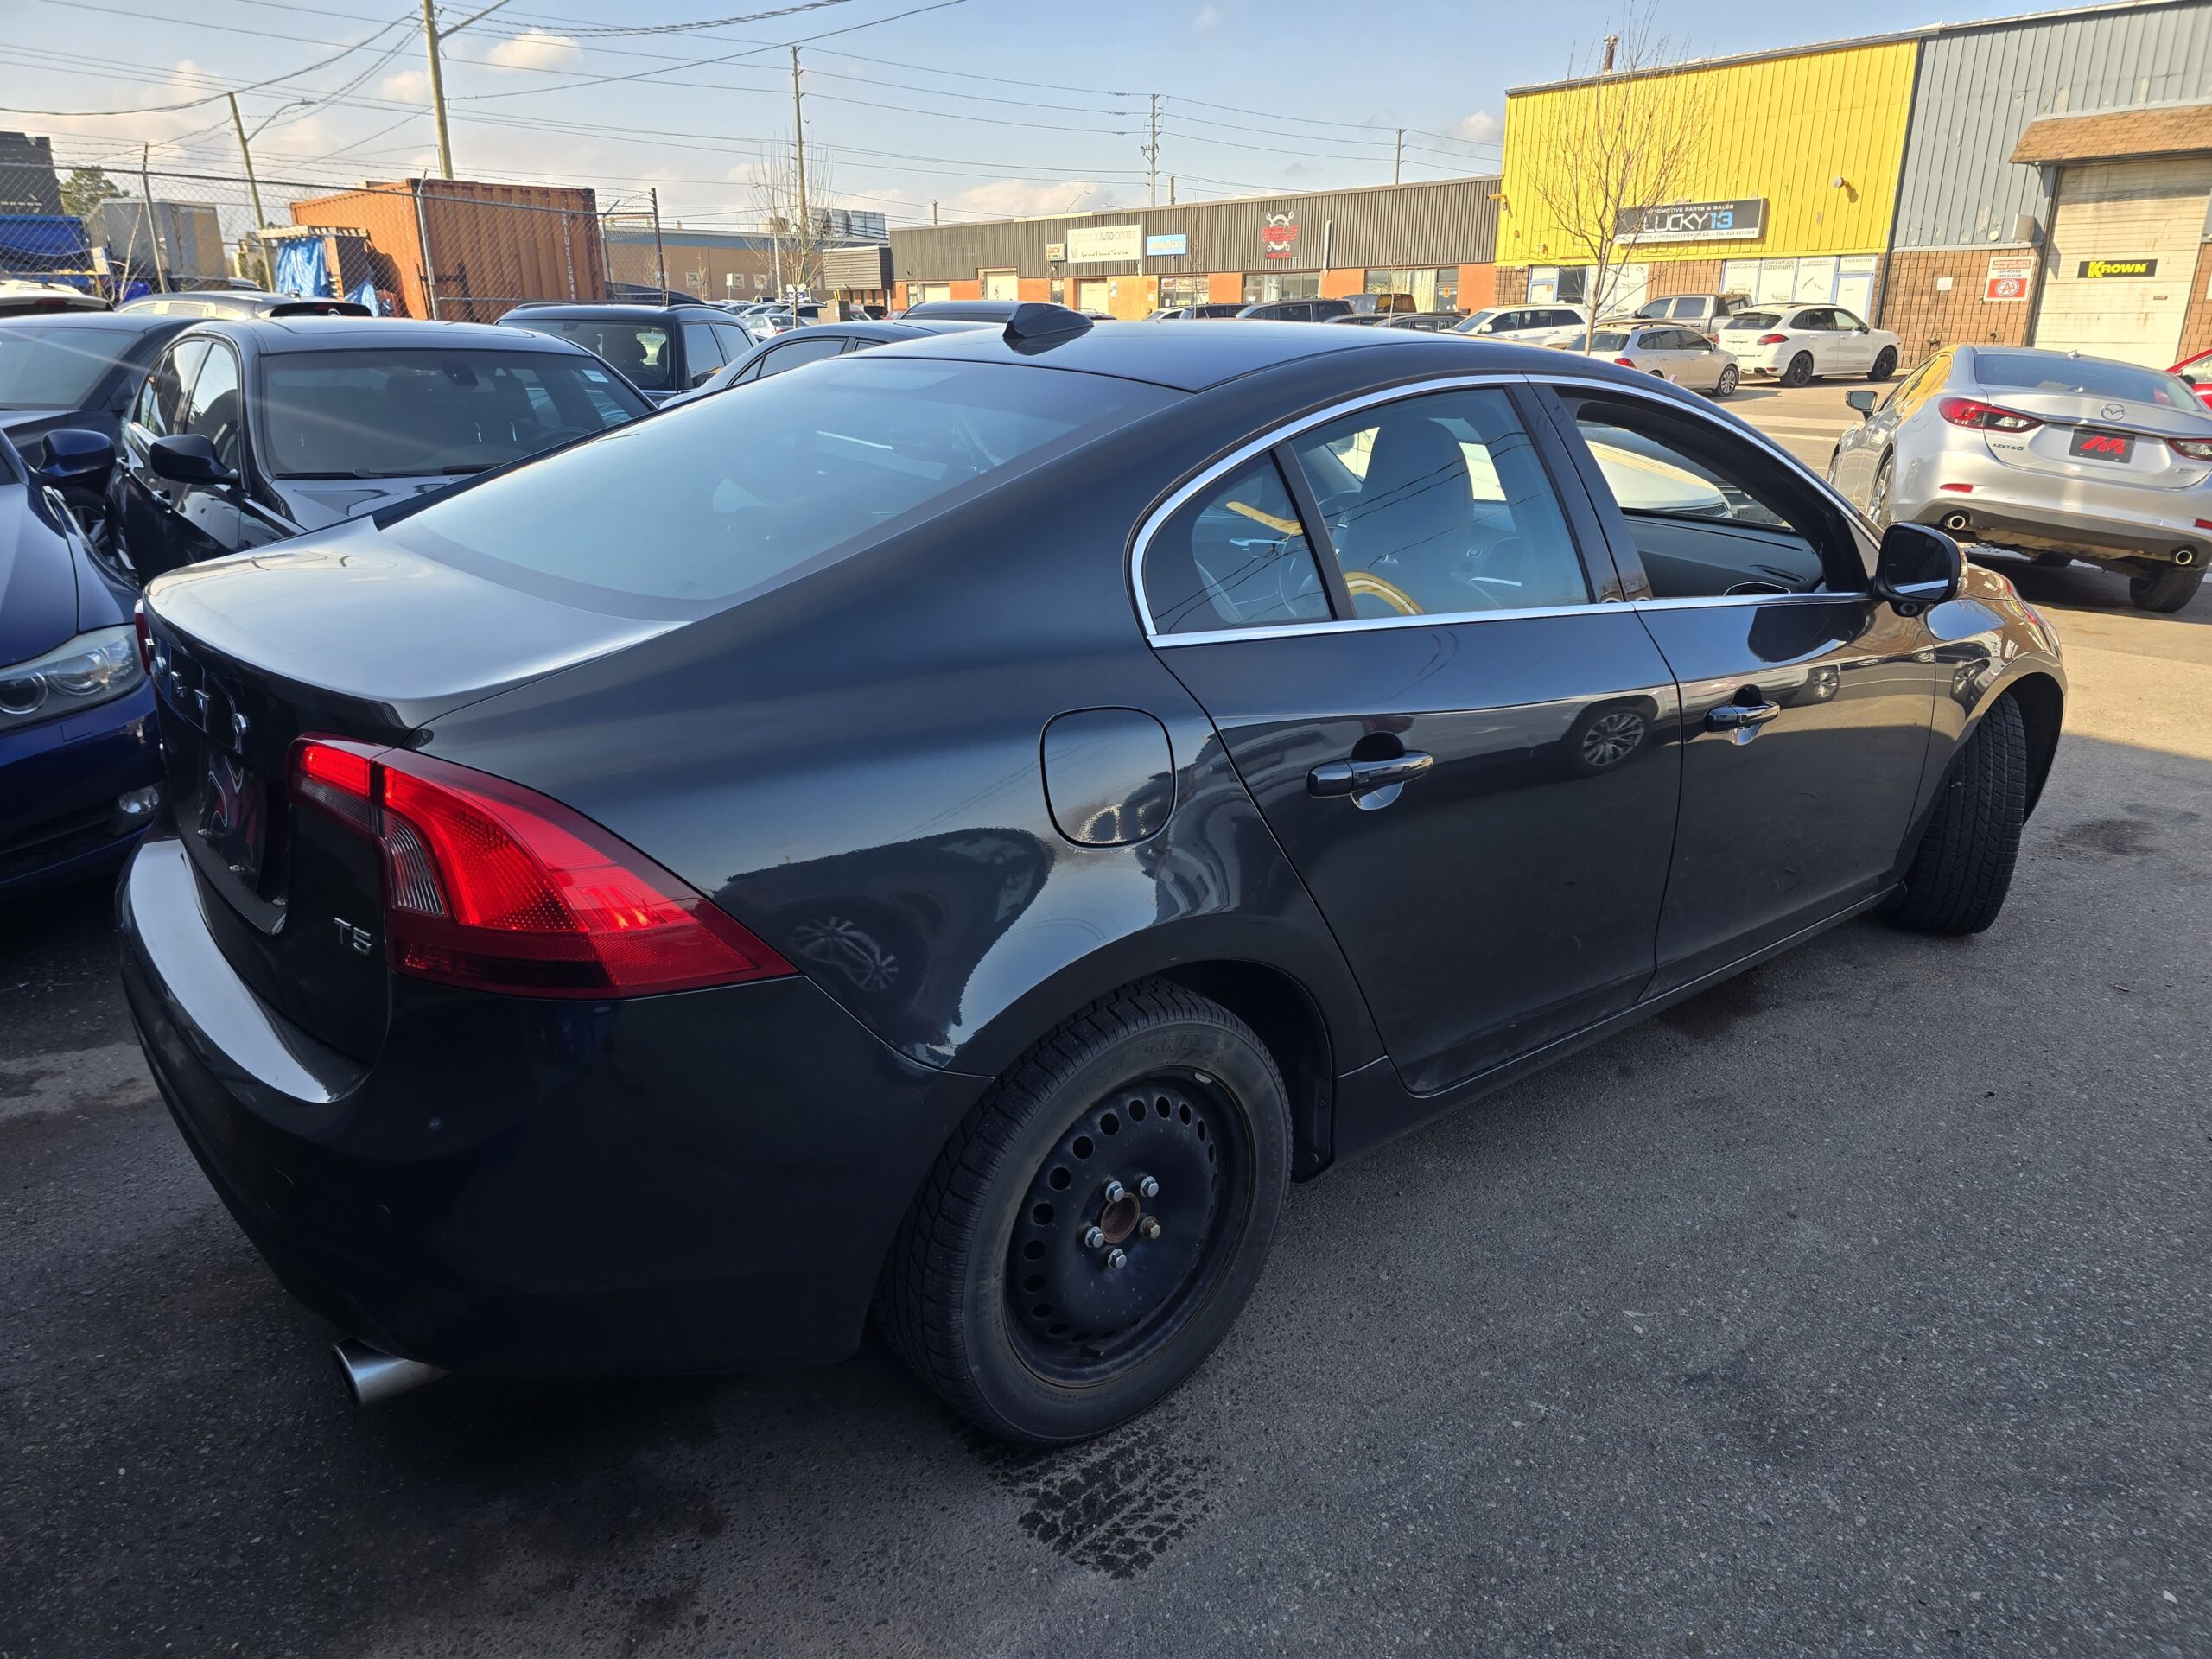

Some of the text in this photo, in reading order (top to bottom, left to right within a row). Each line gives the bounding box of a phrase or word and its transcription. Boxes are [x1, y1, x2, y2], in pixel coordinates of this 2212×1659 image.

[1099, 231, 1113, 241] AUTO
[1262, 233, 1297, 242] GARAGE
[1999, 282, 2016, 293] CAA
[334, 917, 372, 954] T5
